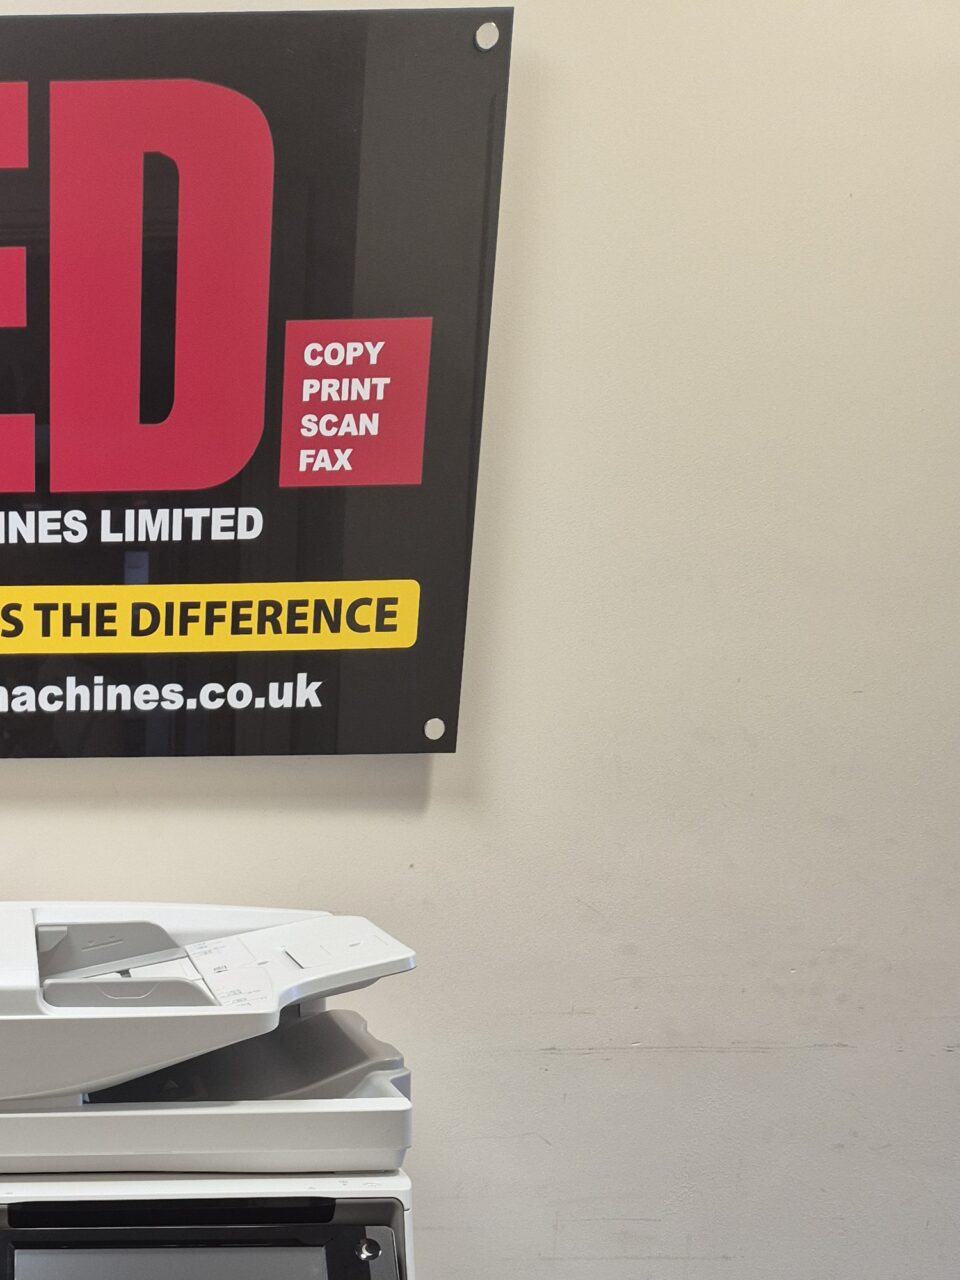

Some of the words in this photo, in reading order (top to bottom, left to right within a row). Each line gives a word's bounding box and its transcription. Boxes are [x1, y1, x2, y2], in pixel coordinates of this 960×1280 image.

[304, 341, 385, 366] COPY
[302, 377, 391, 402] PRINT
[300, 413, 379, 437] SCAN
[298, 448, 353, 472] FAX
[100, 507, 263, 543] LIMITED
[33, 602, 117, 637] THE
[130, 597, 399, 637] DIFFERENCE
